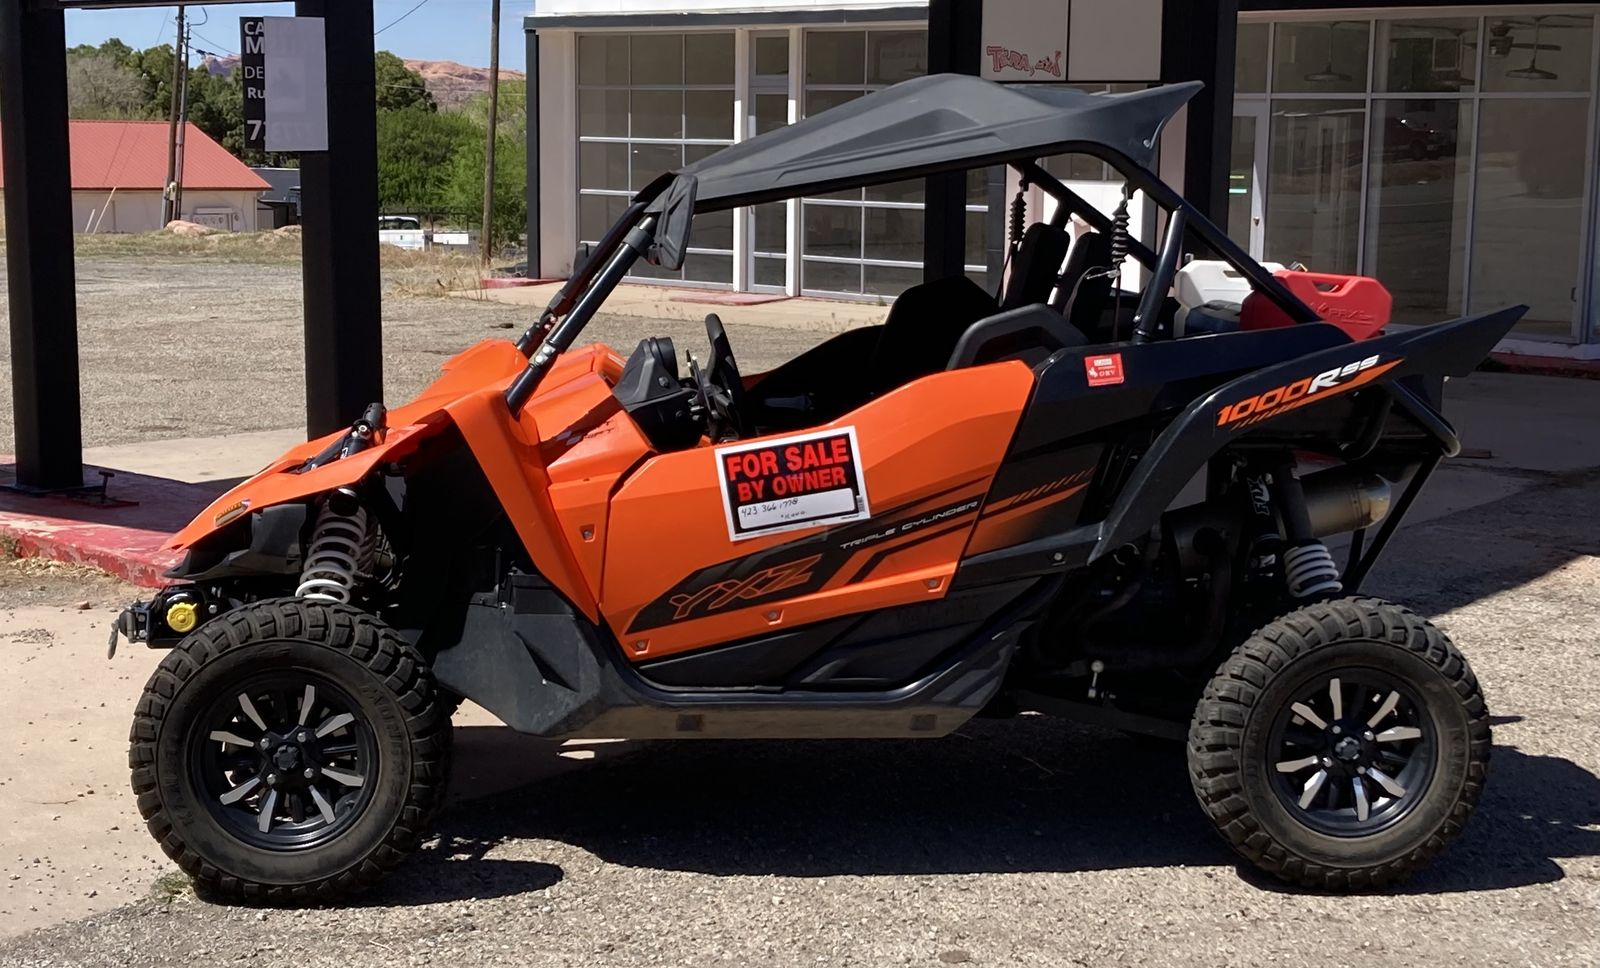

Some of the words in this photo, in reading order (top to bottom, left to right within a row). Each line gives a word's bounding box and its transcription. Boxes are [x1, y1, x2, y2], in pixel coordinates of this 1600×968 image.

[727, 450, 779, 481] FOR
[785, 438, 849, 471] SALE
[737, 479, 765, 502] BY
[772, 466, 847, 496] OWNER
[741, 506, 758, 518] 423
[761, 503, 777, 513] 366
[840, 528, 896, 549] TRIPLE
[901, 501, 979, 531] CYLINDER
[669, 553, 824, 620] YXZ
